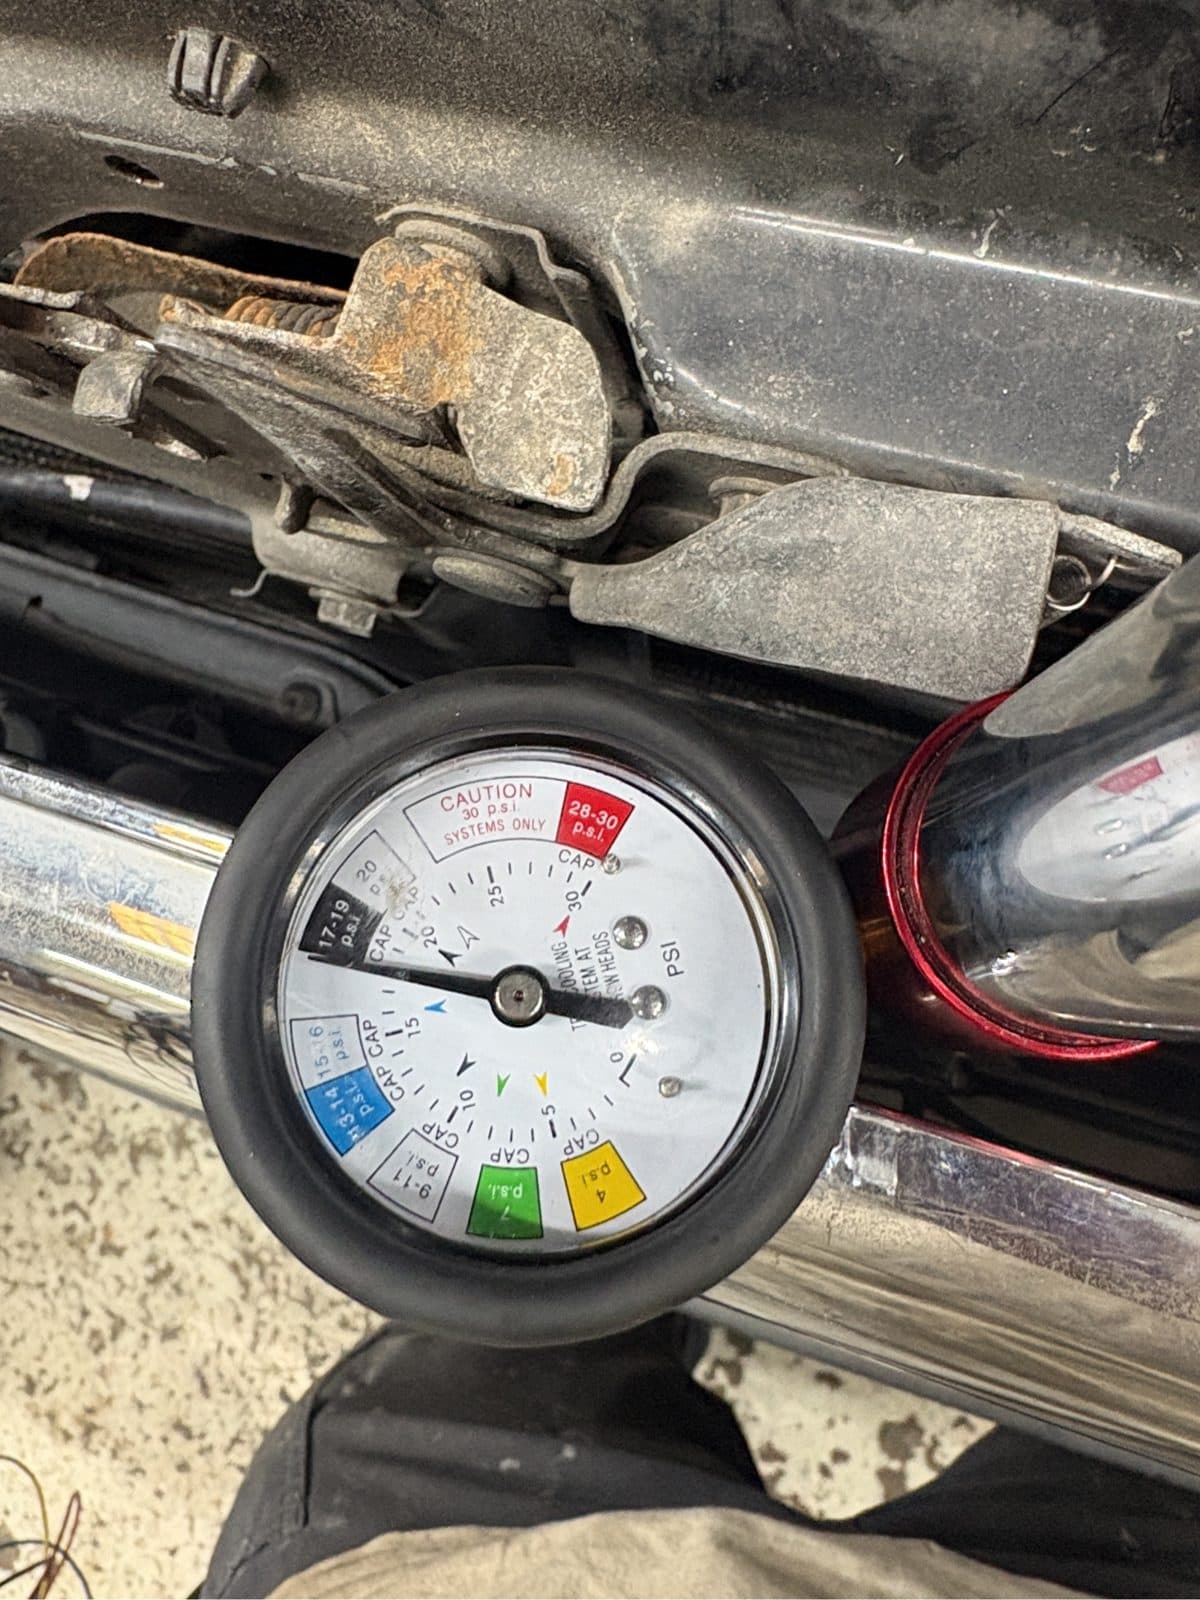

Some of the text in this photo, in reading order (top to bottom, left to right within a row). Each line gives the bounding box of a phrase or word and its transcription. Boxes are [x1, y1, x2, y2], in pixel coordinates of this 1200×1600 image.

[440, 783, 532, 812] CAUTION
[462, 807, 479, 821] 30
[568, 801, 618, 830] 28-30
[444, 818, 546, 846] SYSTEMS ONLY
[572, 821, 604, 842] p.s.i.
[356, 860, 377, 882] 20
[558, 849, 595, 871] CAP
[487, 886, 505, 908] 25
[565, 890, 582, 912] 30
[319, 900, 350, 948] 17-19
[369, 924, 392, 962] CAP
[421, 926, 438, 949] 20
[574, 946, 592, 961] AT
[592, 931, 615, 972] HEADS
[660, 941, 685, 978] PSI
[362, 1019, 384, 1058] CAP
[405, 1017, 421, 1039] 15
[609, 1051, 624, 1063] 0
[375, 1066, 405, 1101] CAP
[459, 1089, 476, 1112] 10
[541, 1104, 556, 1116] 5
[324, 1085, 361, 1142] 13-14
[422, 1122, 460, 1149] CAP
[563, 1128, 600, 1156] CAP
[490, 1148, 530, 1164] CAP
[393, 1168, 433, 1200] 9-11
[596, 1188, 607, 1204] 4
[500, 1205, 511, 1221] 7
